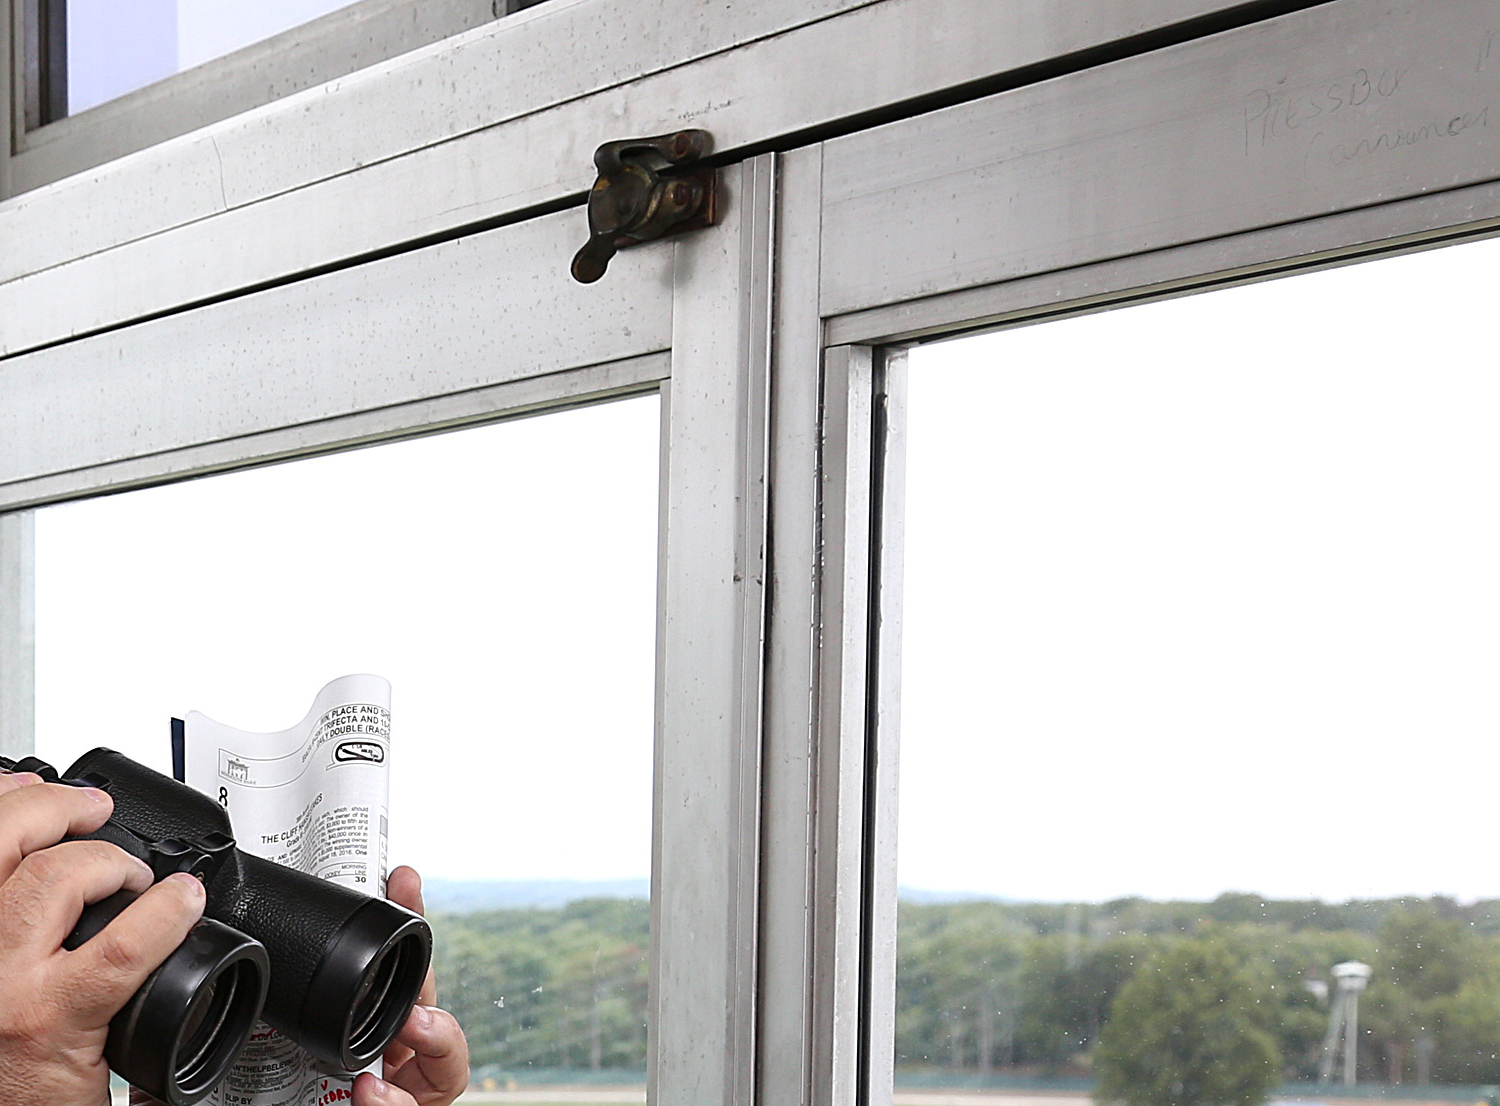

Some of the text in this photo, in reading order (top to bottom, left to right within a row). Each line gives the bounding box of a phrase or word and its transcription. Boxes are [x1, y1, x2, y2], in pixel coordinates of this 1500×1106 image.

[331, 706, 358, 718] PLACE
[360, 706, 379, 715] AND
[324, 715, 358, 731] TRIFECTA
[360, 715, 379, 725] AND
[330, 725, 363, 738] DOUBLE
[219, 786, 228, 808] 8
[261, 834, 279, 844] THE
[281, 825, 298, 841] CLIFF
[225, 1093, 240, 1103] SLIP
[241, 1098, 252, 1106] BY
